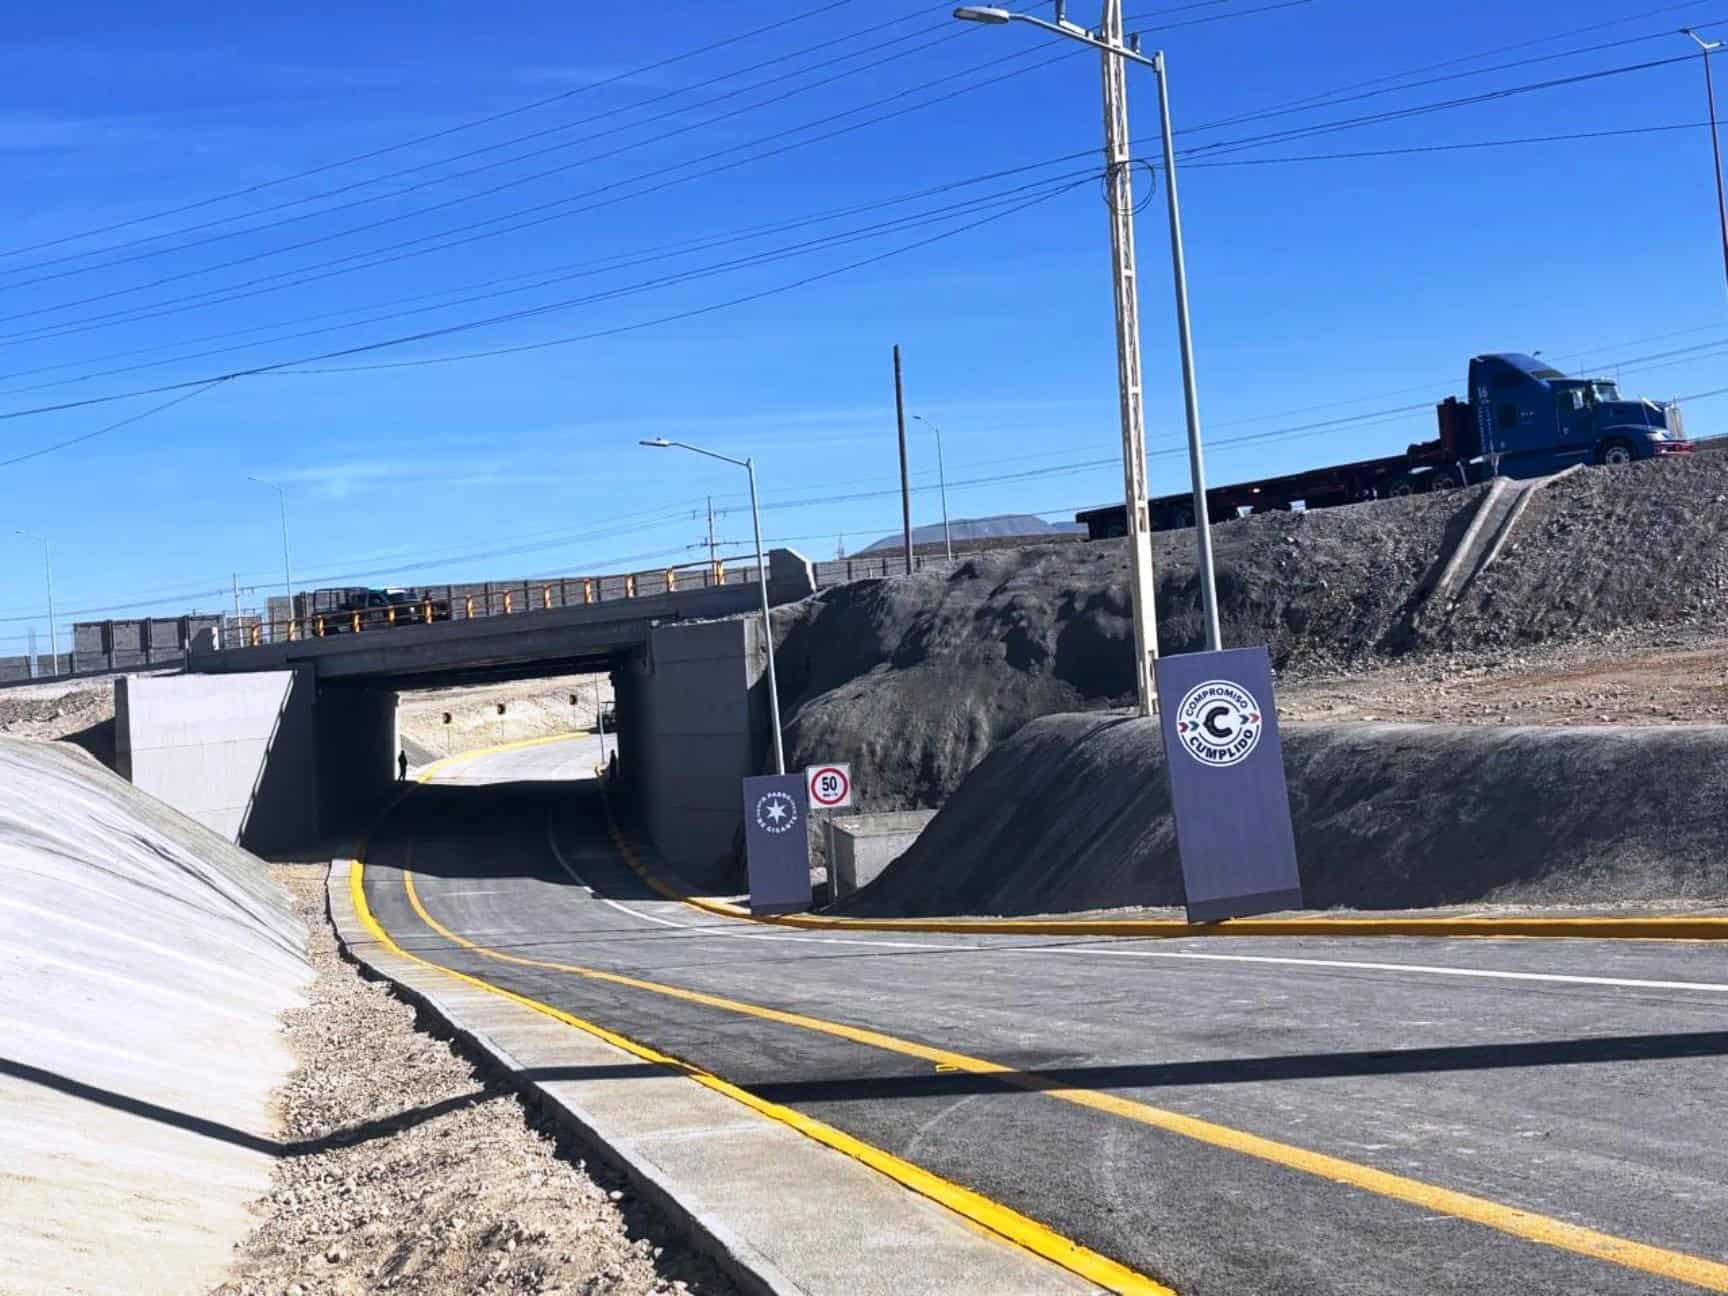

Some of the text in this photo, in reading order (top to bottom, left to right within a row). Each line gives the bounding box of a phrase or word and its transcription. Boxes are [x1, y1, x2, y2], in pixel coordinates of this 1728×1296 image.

[1186, 688, 1247, 716] COMPROMISO
[1189, 730, 1253, 759] CUMPLIDO
[822, 776, 837, 791] 50
